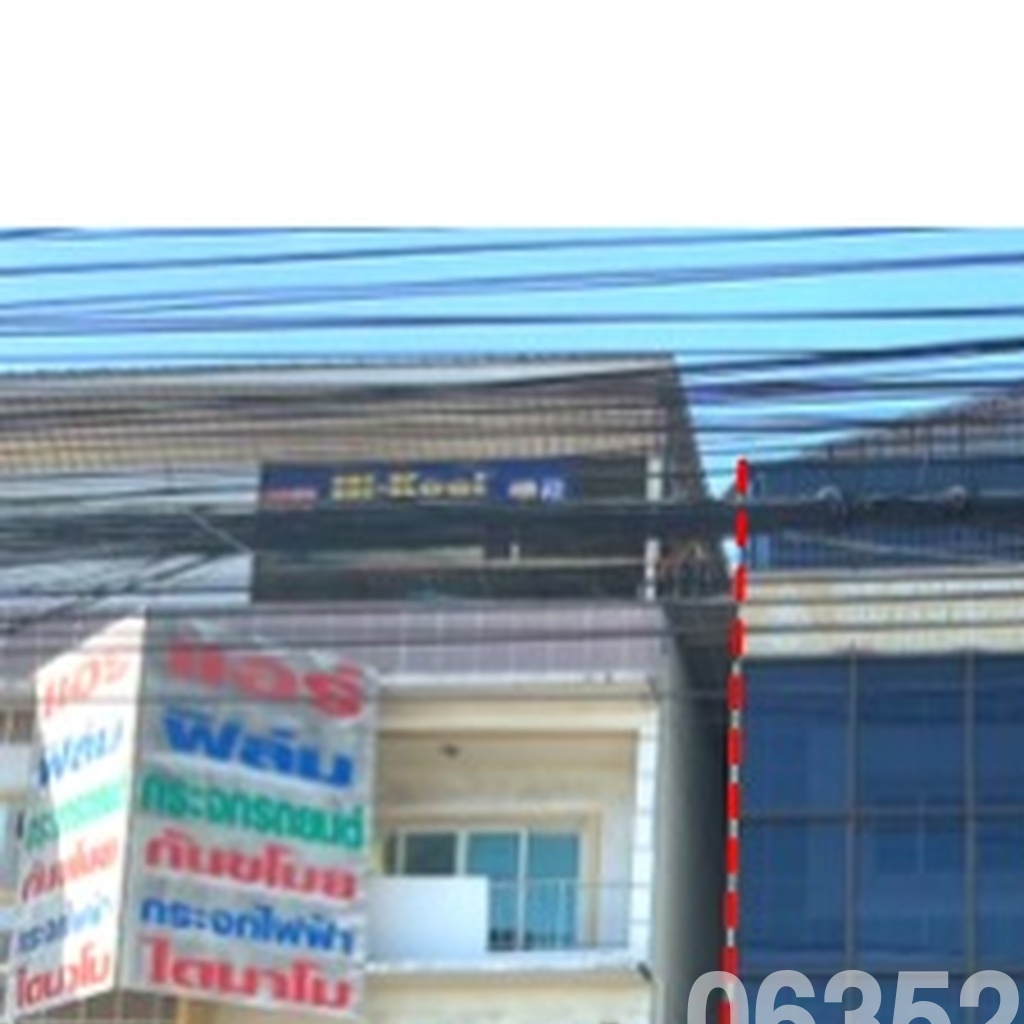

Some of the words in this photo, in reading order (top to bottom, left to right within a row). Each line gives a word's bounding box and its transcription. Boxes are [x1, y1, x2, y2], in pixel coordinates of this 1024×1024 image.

[166, 636, 366, 719] แอร์
[163, 704, 355, 790] ฟิล์ม
[144, 826, 358, 901] กันขโมย
[139, 896, 355, 957] กระจกไฟฟ้า
[141, 934, 356, 1011] ไดนาโม
